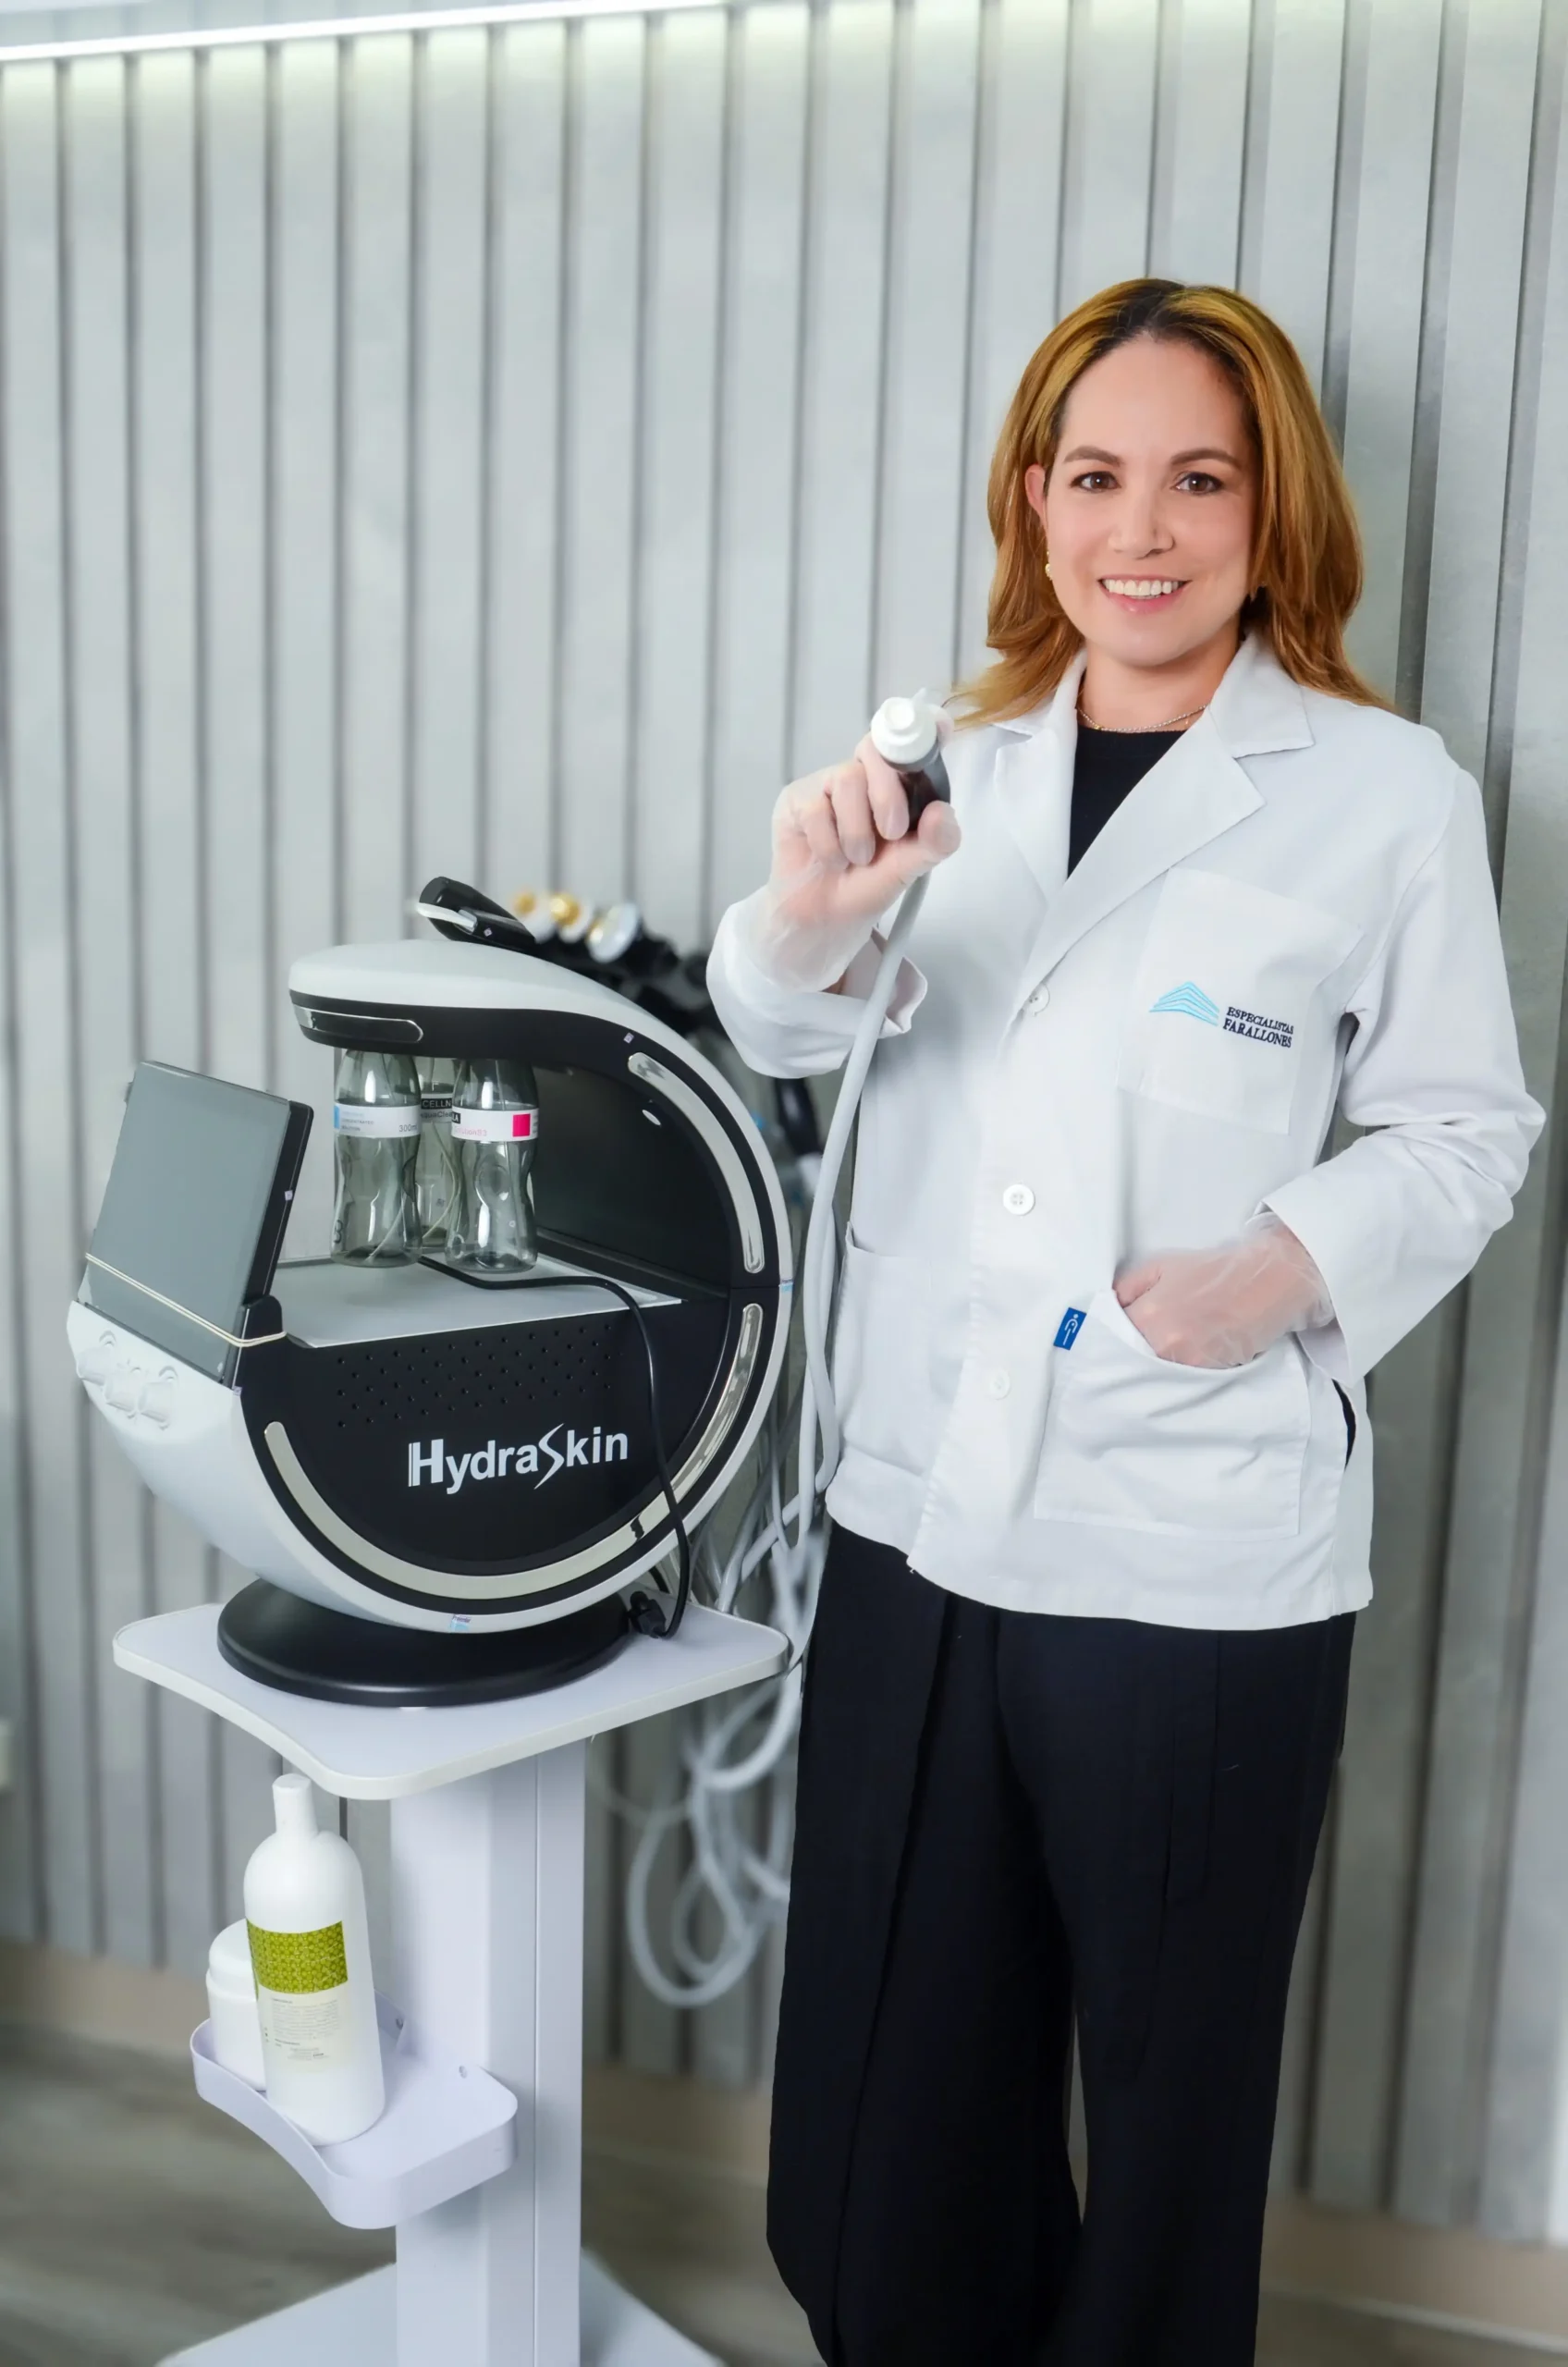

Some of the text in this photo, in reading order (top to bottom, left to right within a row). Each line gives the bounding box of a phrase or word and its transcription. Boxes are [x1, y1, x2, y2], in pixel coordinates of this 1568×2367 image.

[1222, 1018, 1292, 1049] FARALLONES
[1226, 1006, 1293, 1035] ESPECIALISTAS
[408, 1423, 629, 1495] HydraSkin
